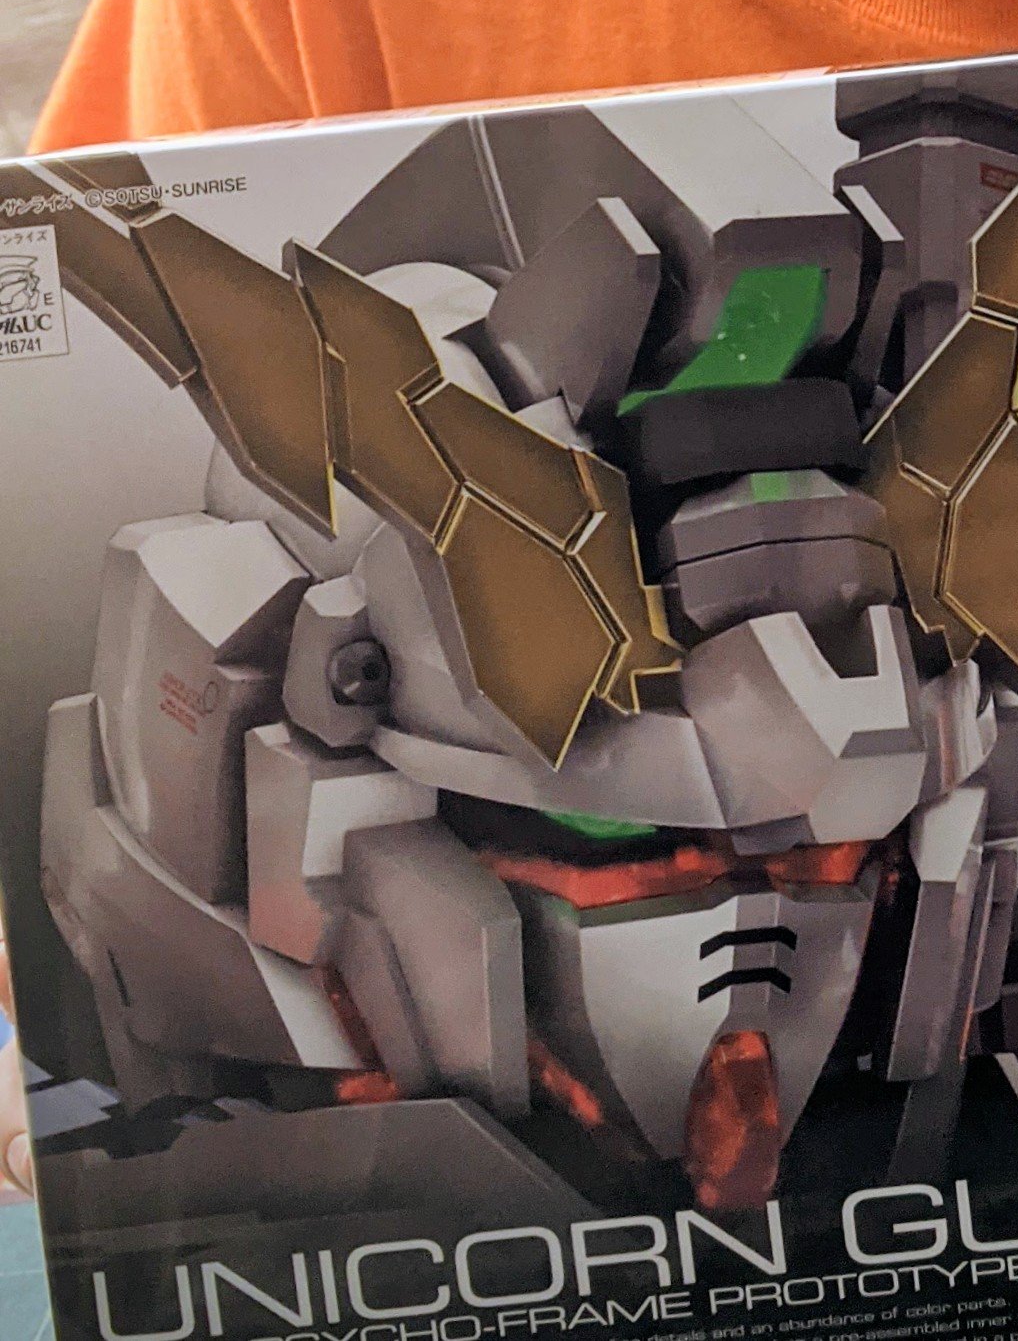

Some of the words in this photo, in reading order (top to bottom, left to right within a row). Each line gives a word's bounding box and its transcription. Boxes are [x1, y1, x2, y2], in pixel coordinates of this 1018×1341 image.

[0, 337, 42, 356] 16741
[92, 1200, 787, 1341] UNICORN
[713, 1325, 745, 1340] and
[751, 1324, 773, 1336] an
[779, 1313, 875, 1332] abundance
[881, 1307, 898, 1320] of
[906, 1303, 950, 1319] color
[966, 1315, 1012, 1329] inner
